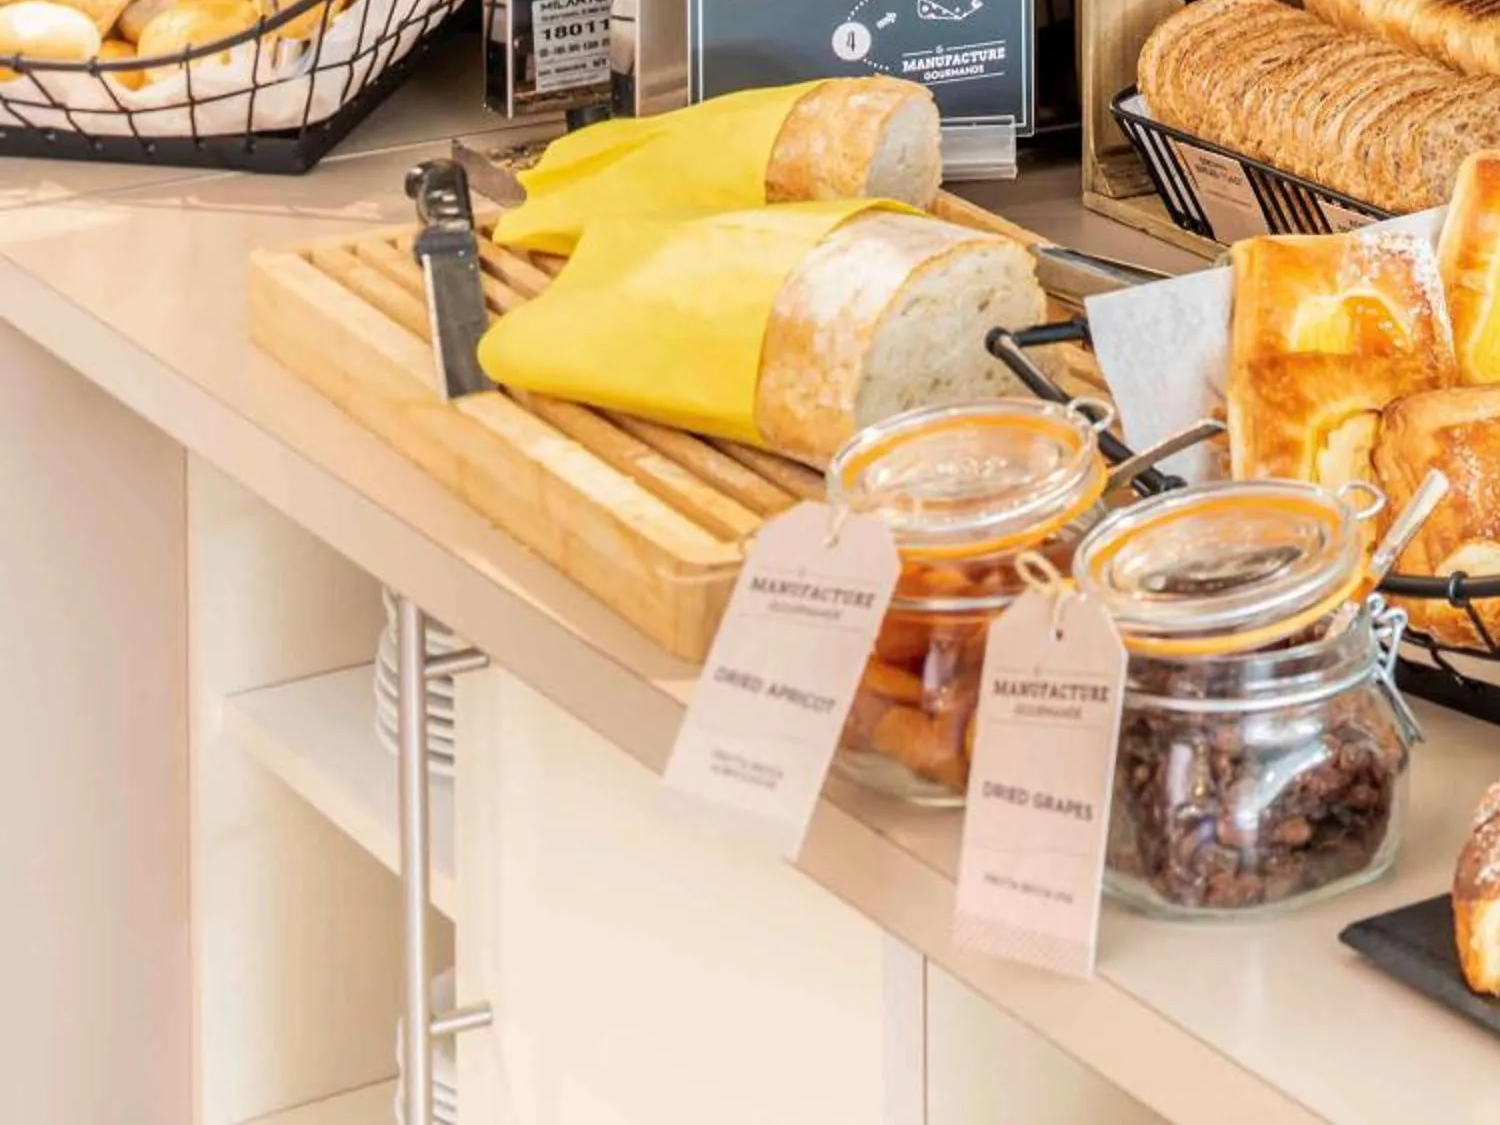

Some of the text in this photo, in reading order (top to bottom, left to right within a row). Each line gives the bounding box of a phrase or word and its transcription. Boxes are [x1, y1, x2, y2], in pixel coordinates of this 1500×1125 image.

[902, 46, 1006, 72] MANUFACTURE
[750, 576, 877, 609] MANUFACTURE
[713, 666, 837, 715] DRIED APRICOT
[993, 679, 1110, 702] MANUFACTURE
[982, 780, 1095, 822] DRIED GRAPES
